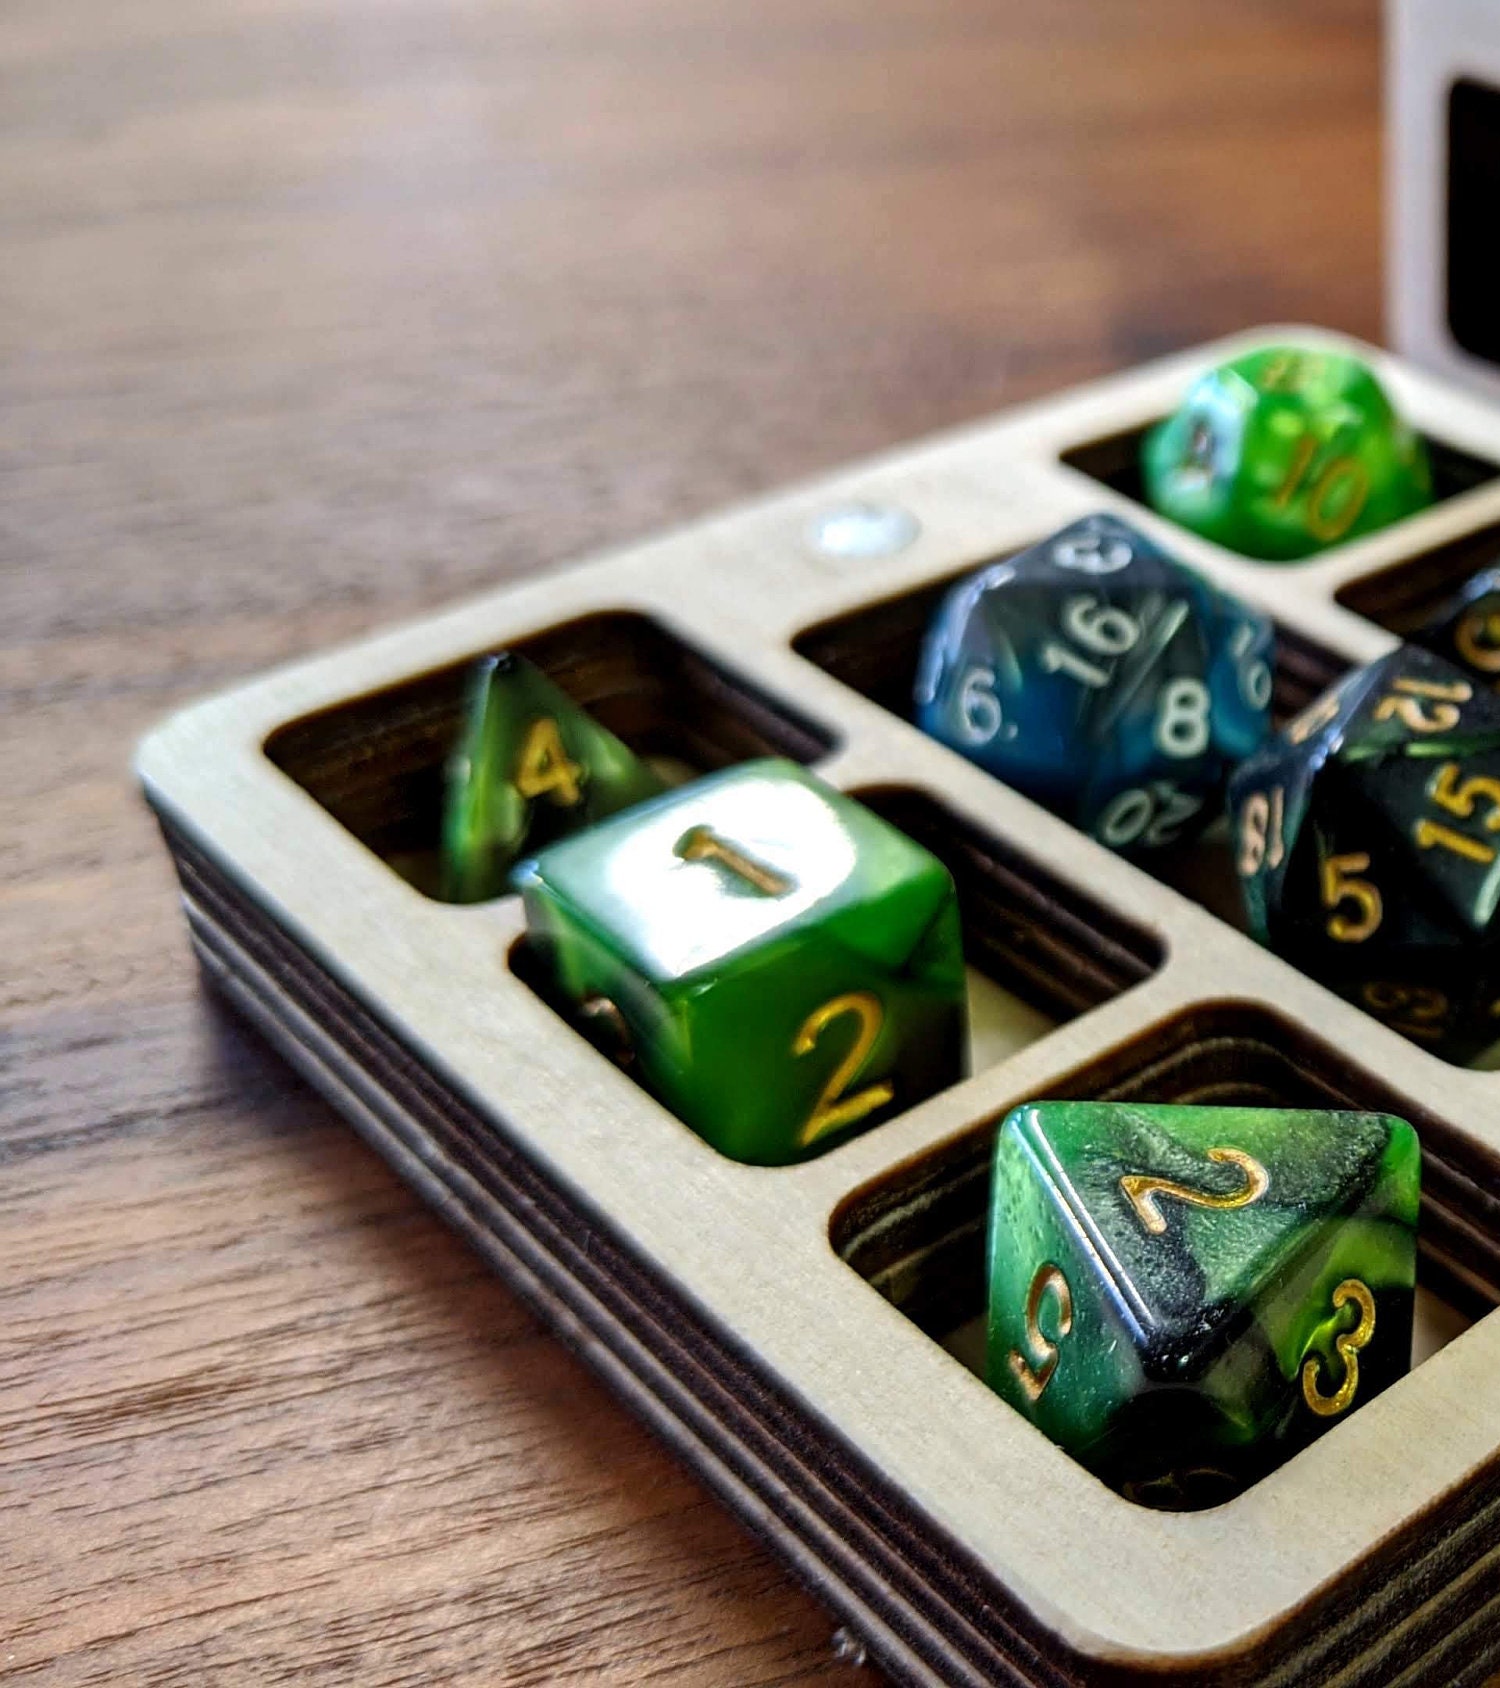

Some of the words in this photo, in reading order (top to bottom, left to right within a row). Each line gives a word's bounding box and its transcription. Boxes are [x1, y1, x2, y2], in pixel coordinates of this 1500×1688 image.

[1276, 434, 1368, 541] 10
[1040, 592, 1141, 688] 16
[1154, 676, 1211, 758] 8
[1373, 675, 1474, 735] 12
[515, 717, 582, 806] 4
[1100, 783, 1200, 847] 20
[671, 823, 800, 900] 1
[1321, 851, 1384, 943] 5
[790, 990, 896, 1148] 2
[1120, 1146, 1270, 1235] 2
[1008, 1262, 1073, 1401] 5
[1302, 1278, 1377, 1417] 3
